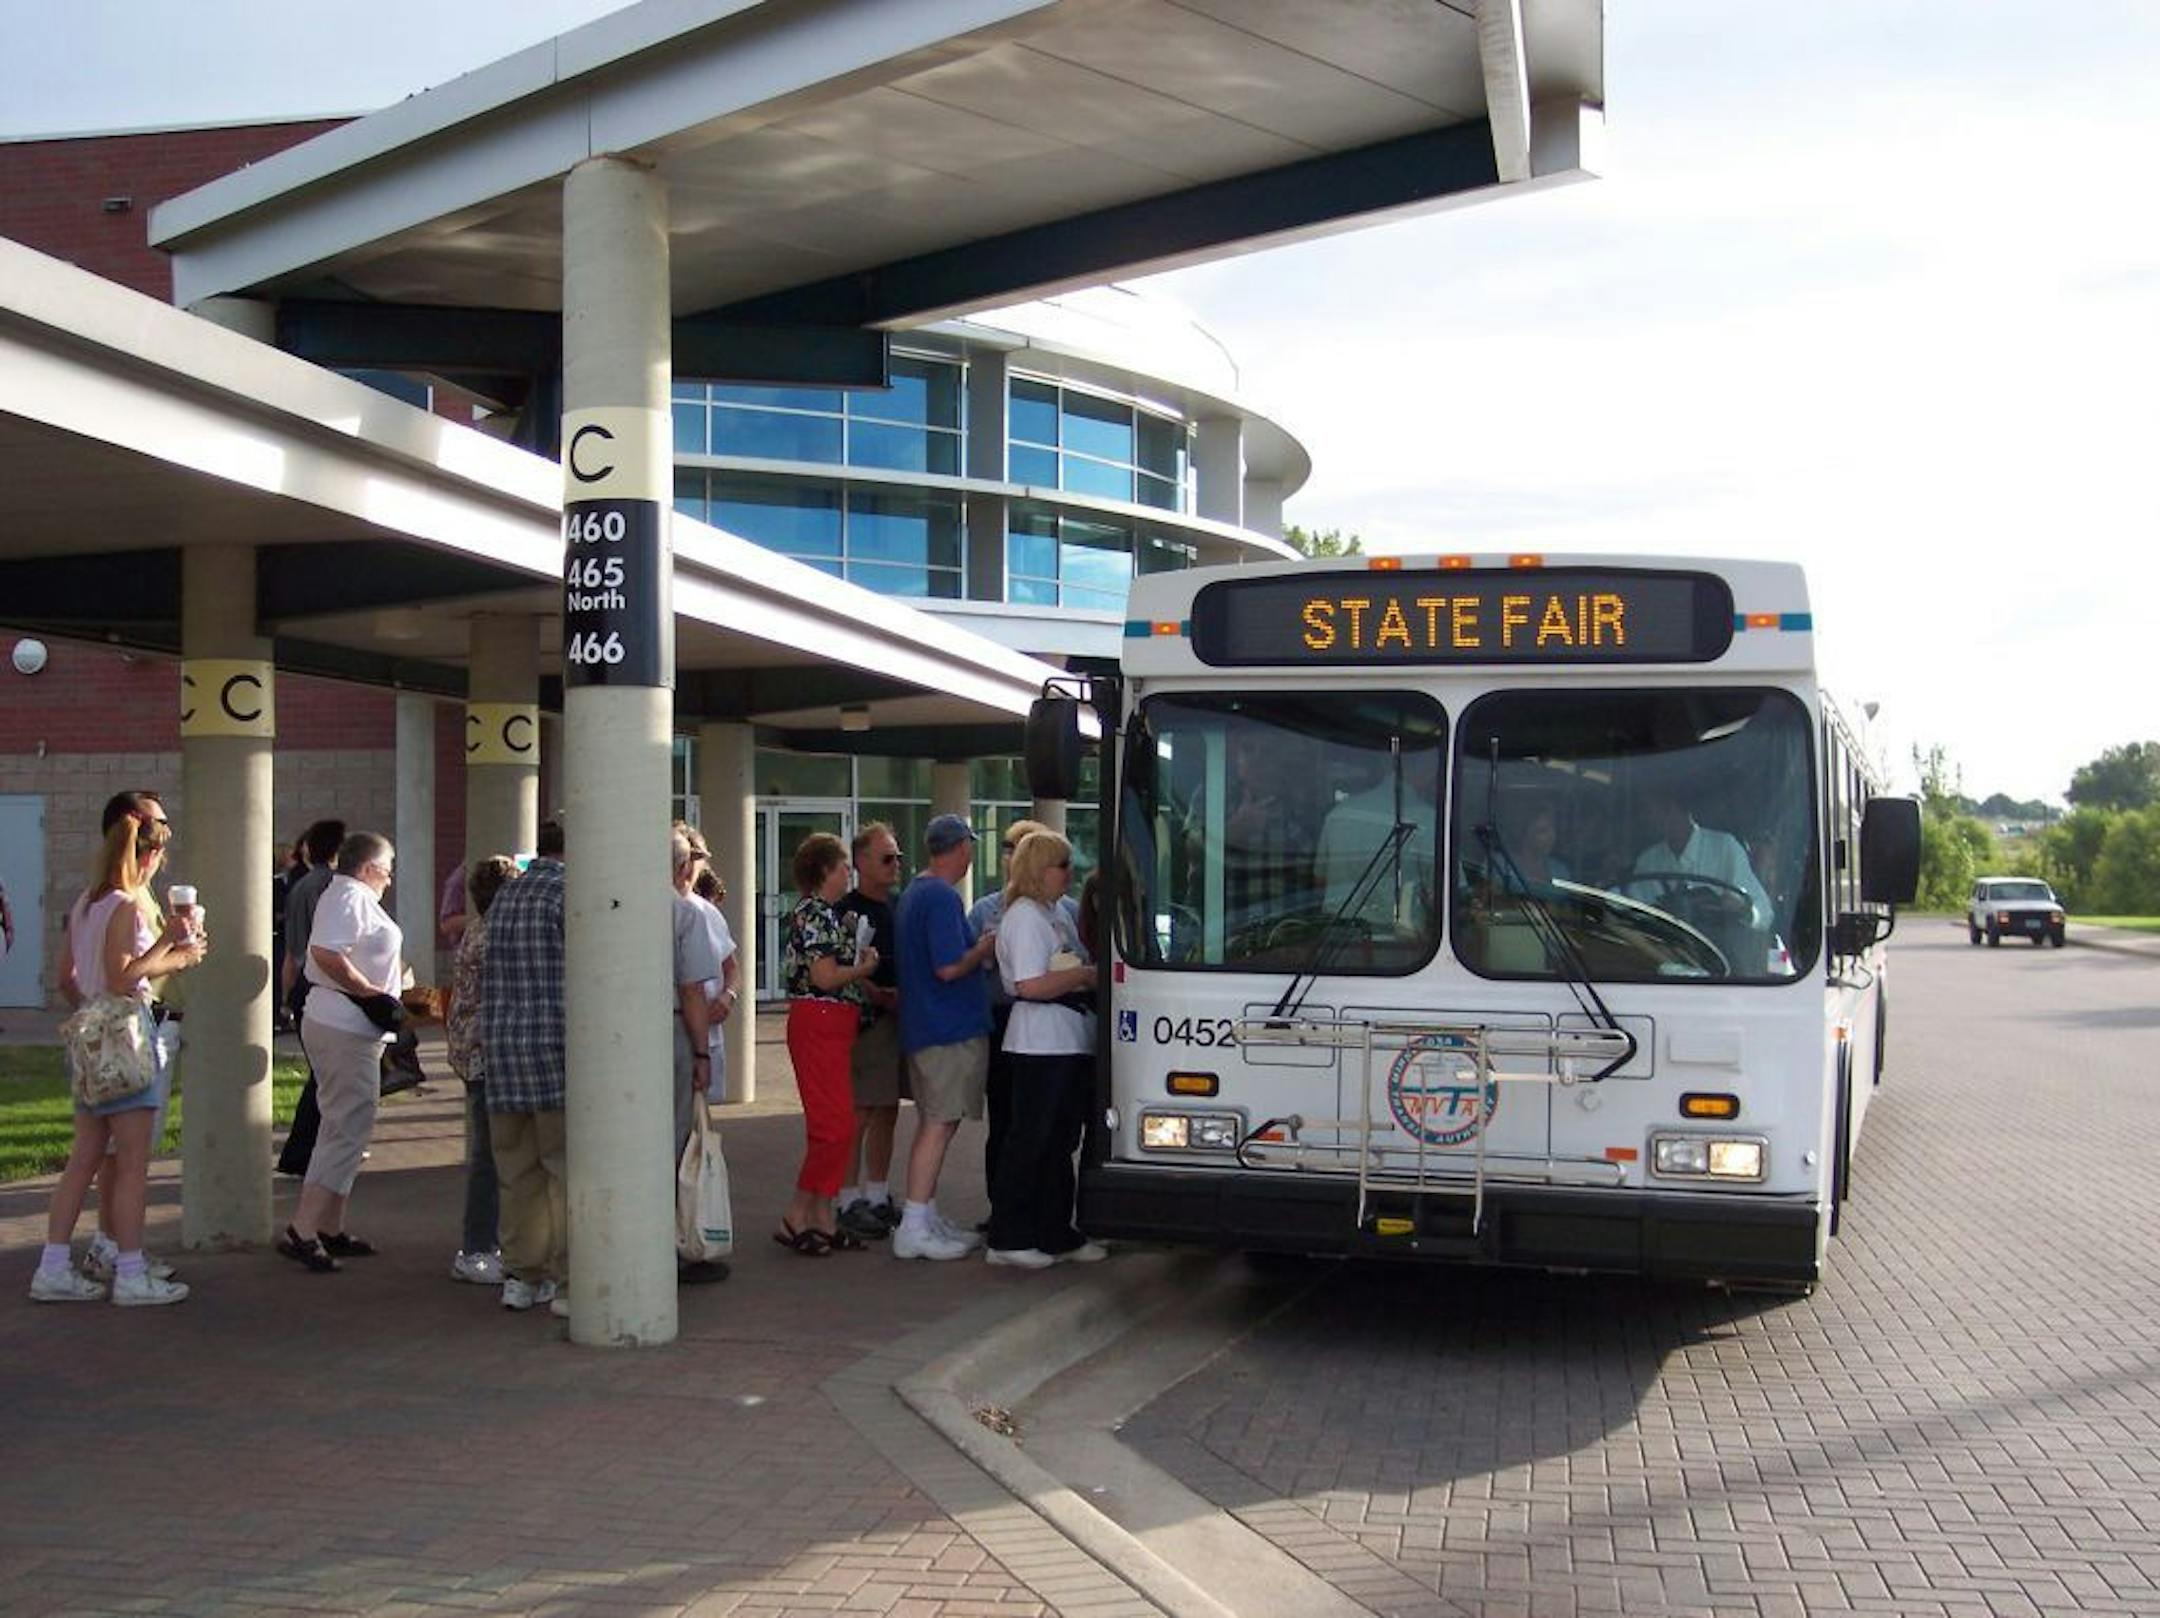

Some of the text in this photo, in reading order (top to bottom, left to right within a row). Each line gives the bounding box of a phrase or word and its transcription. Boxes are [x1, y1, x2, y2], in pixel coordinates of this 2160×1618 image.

[570, 424, 614, 483] C
[568, 512, 626, 543] 460
[568, 558, 625, 588] 465
[568, 588, 626, 612] North
[1303, 594, 1625, 649] STATE FAIR
[568, 631, 626, 664] 466
[221, 674, 262, 721] C
[502, 715, 532, 752] C
[1153, 1016, 1236, 1047] 0452
[1401, 1086, 1479, 1116] MVTA
